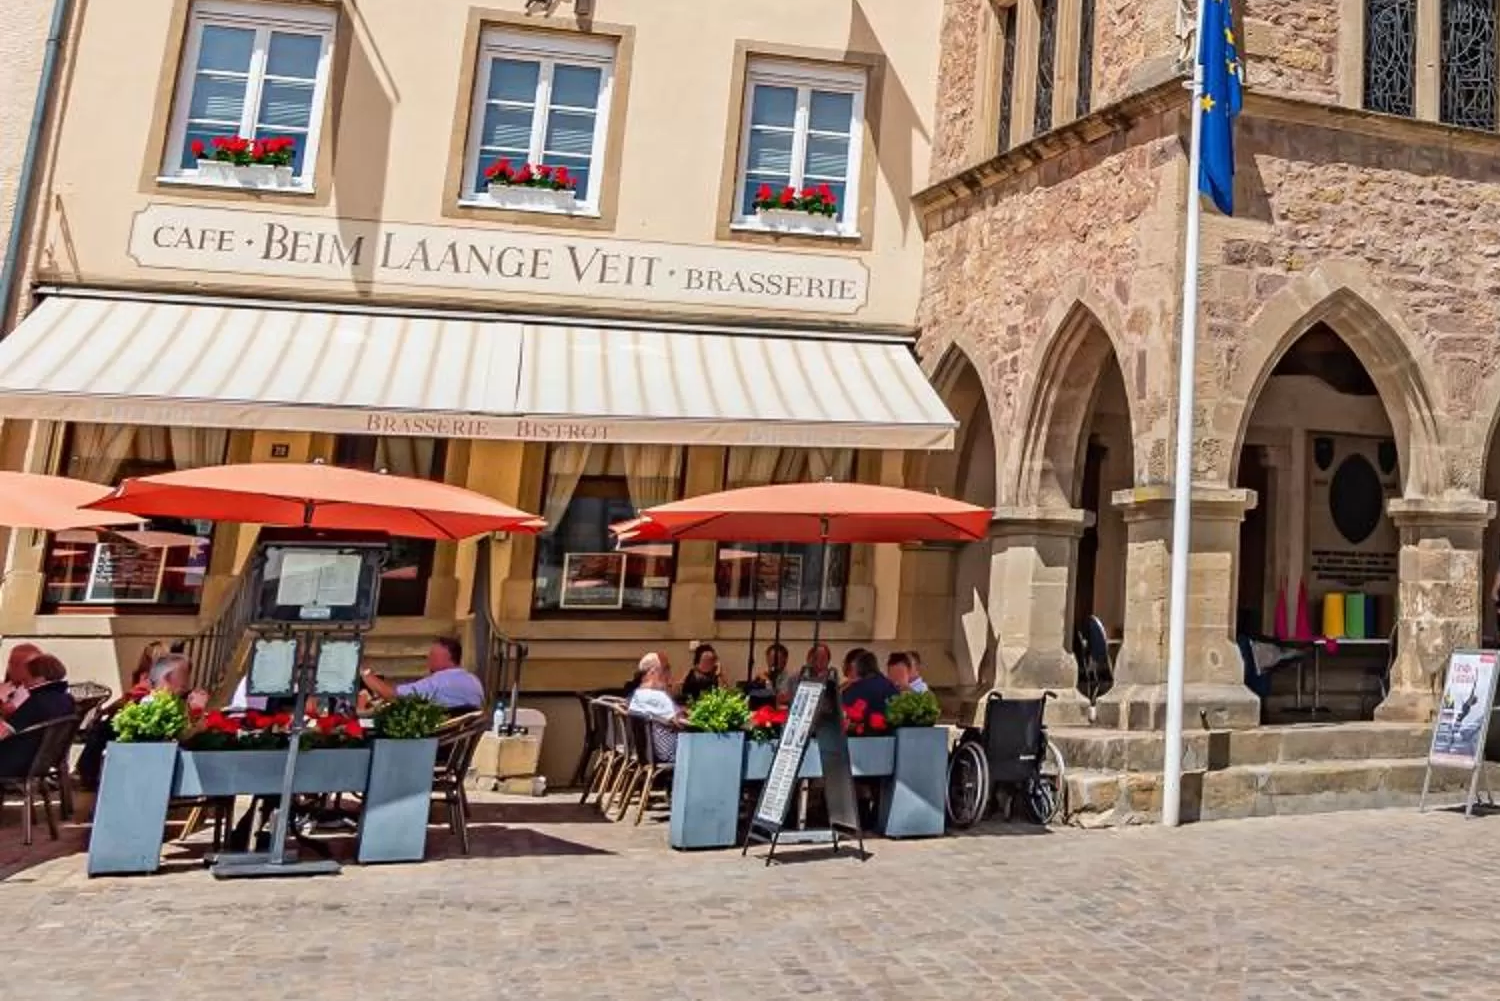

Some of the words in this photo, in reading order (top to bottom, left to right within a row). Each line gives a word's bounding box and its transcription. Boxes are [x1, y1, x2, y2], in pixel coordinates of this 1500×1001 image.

[153, 225, 236, 252] CAFE
[261, 222, 364, 266] BEIM
[380, 232, 552, 278] LAANGE
[568, 246, 662, 287] VEIT
[684, 267, 857, 299] BRASSERIE
[365, 414, 489, 435] BRASSERIE
